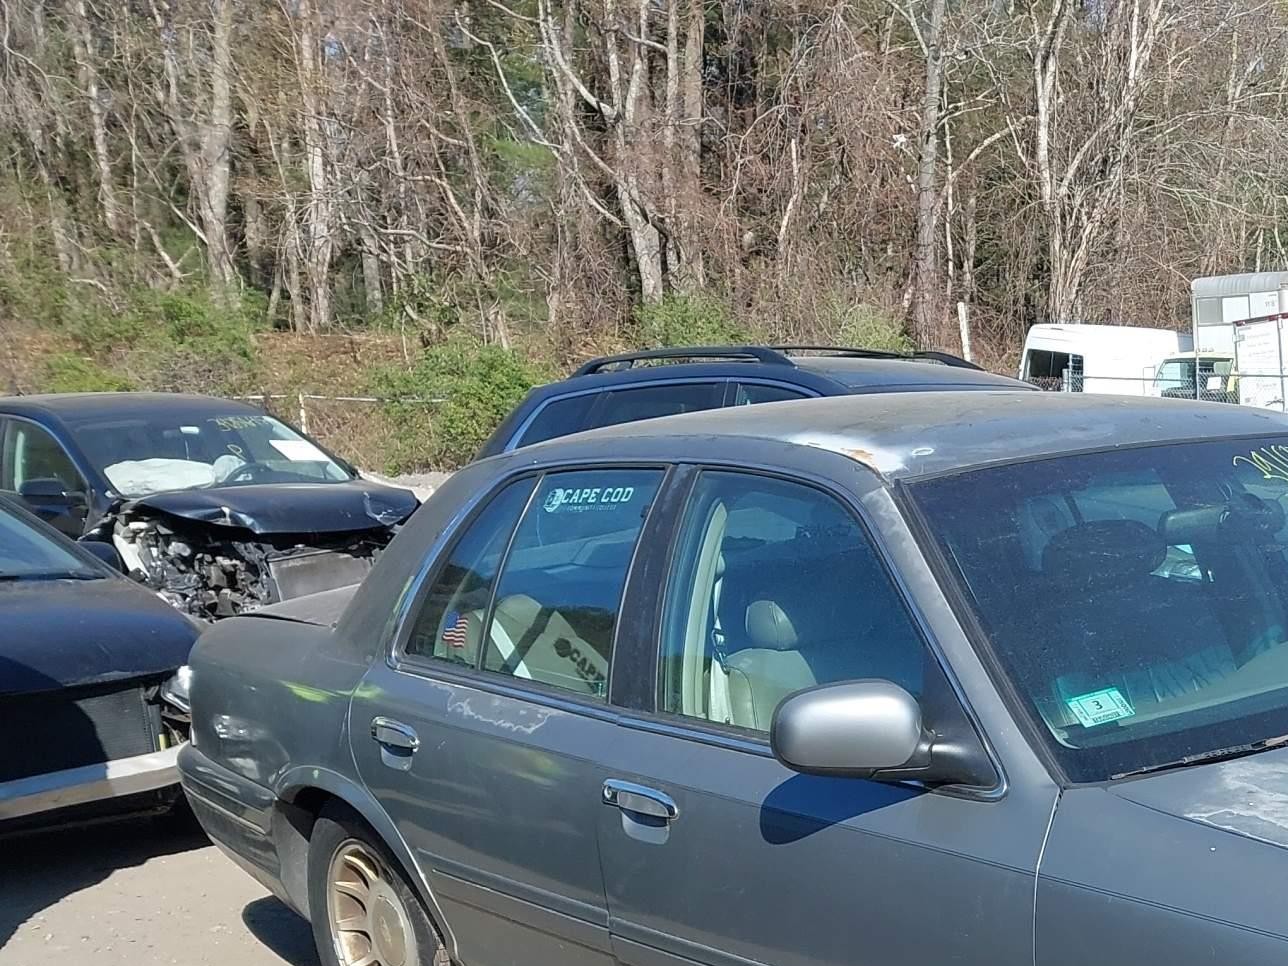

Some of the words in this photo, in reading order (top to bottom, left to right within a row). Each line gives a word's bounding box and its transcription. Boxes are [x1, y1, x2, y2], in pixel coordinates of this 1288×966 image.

[562, 488, 601, 503] CAPE
[601, 487, 634, 503] COD
[1092, 700, 1103, 710] 3
